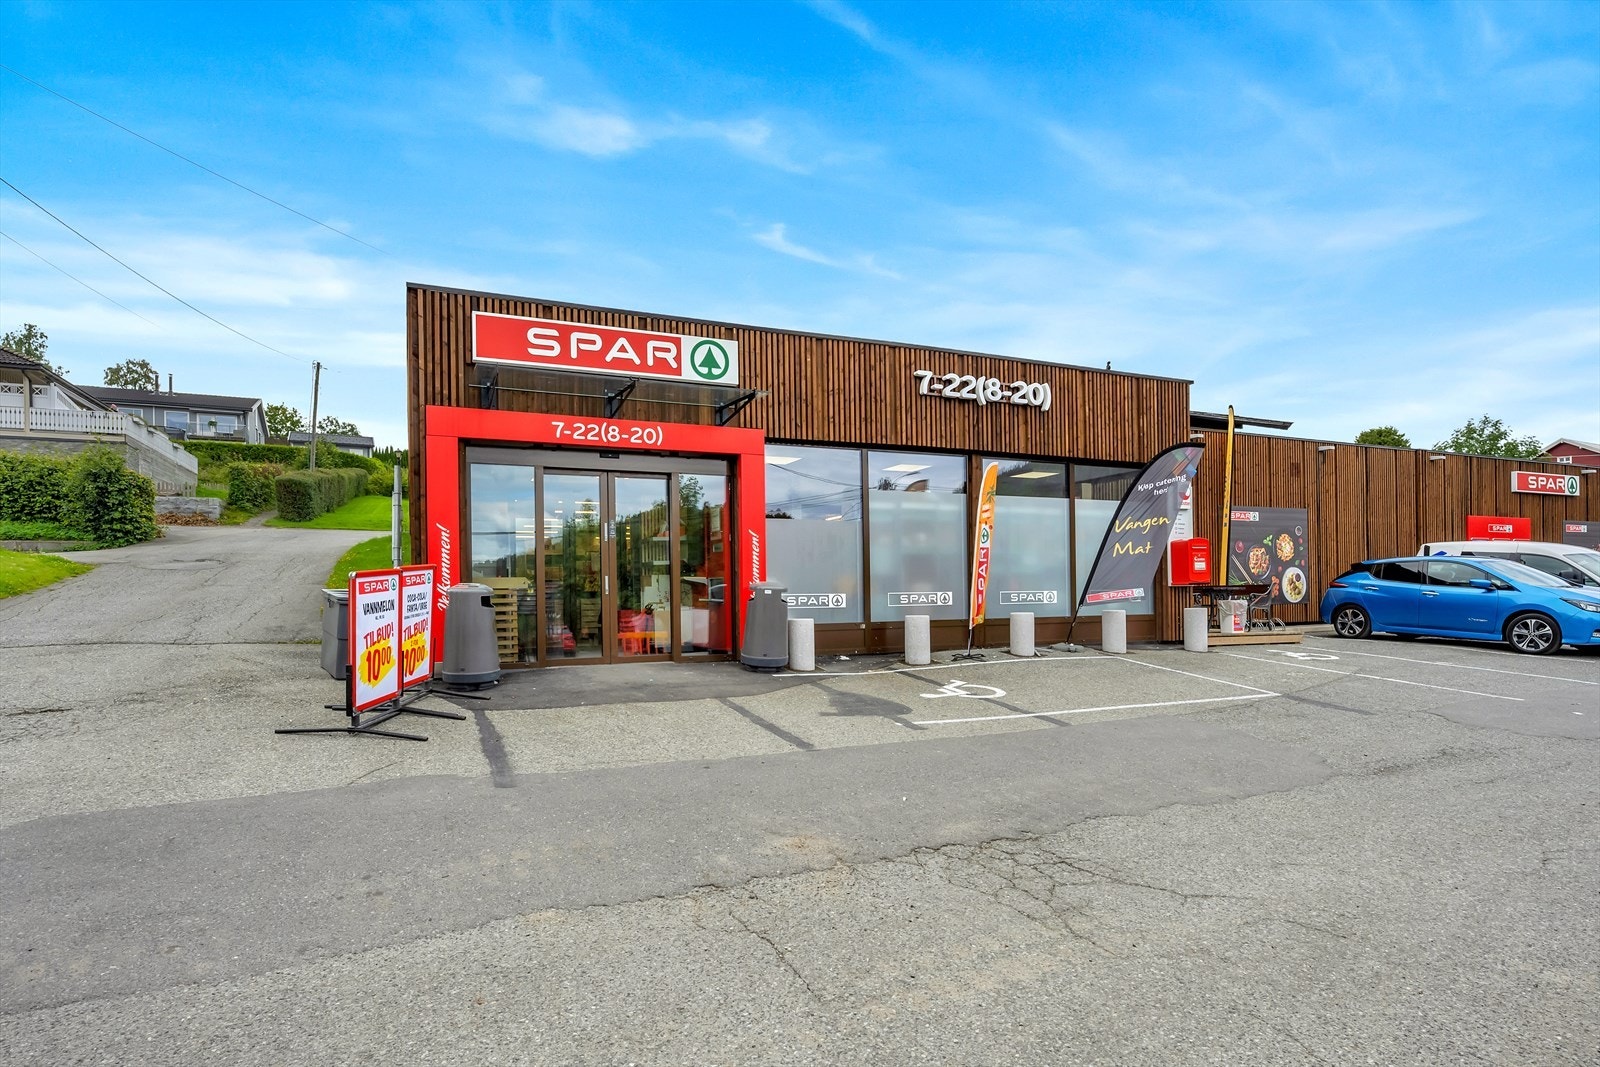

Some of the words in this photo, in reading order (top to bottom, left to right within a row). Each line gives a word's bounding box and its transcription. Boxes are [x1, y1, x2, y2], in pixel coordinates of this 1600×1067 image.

[526, 327, 678, 369] SPAR
[914, 369, 1052, 412] 7-22(8-20)
[551, 421, 663, 446] 7-22(8-20)
[1528, 476, 1565, 490] SPAR
[1114, 515, 1172, 535] Vangen
[1112, 541, 1155, 558] Mat
[436, 522, 451, 611] Velkommen!
[748, 529, 760, 599] ommen!
[364, 582, 389, 592] SPAR
[405, 575, 426, 585] SPAR
[787, 596, 829, 606] SPAR
[900, 594, 937, 604] SPAR
[1010, 593, 1043, 602] SPAR
[1102, 590, 1133, 600] SPAR
[362, 599, 395, 616] VANNMELON
[363, 622, 394, 649] TILBUD!
[403, 617, 429, 641] TILBUD!
